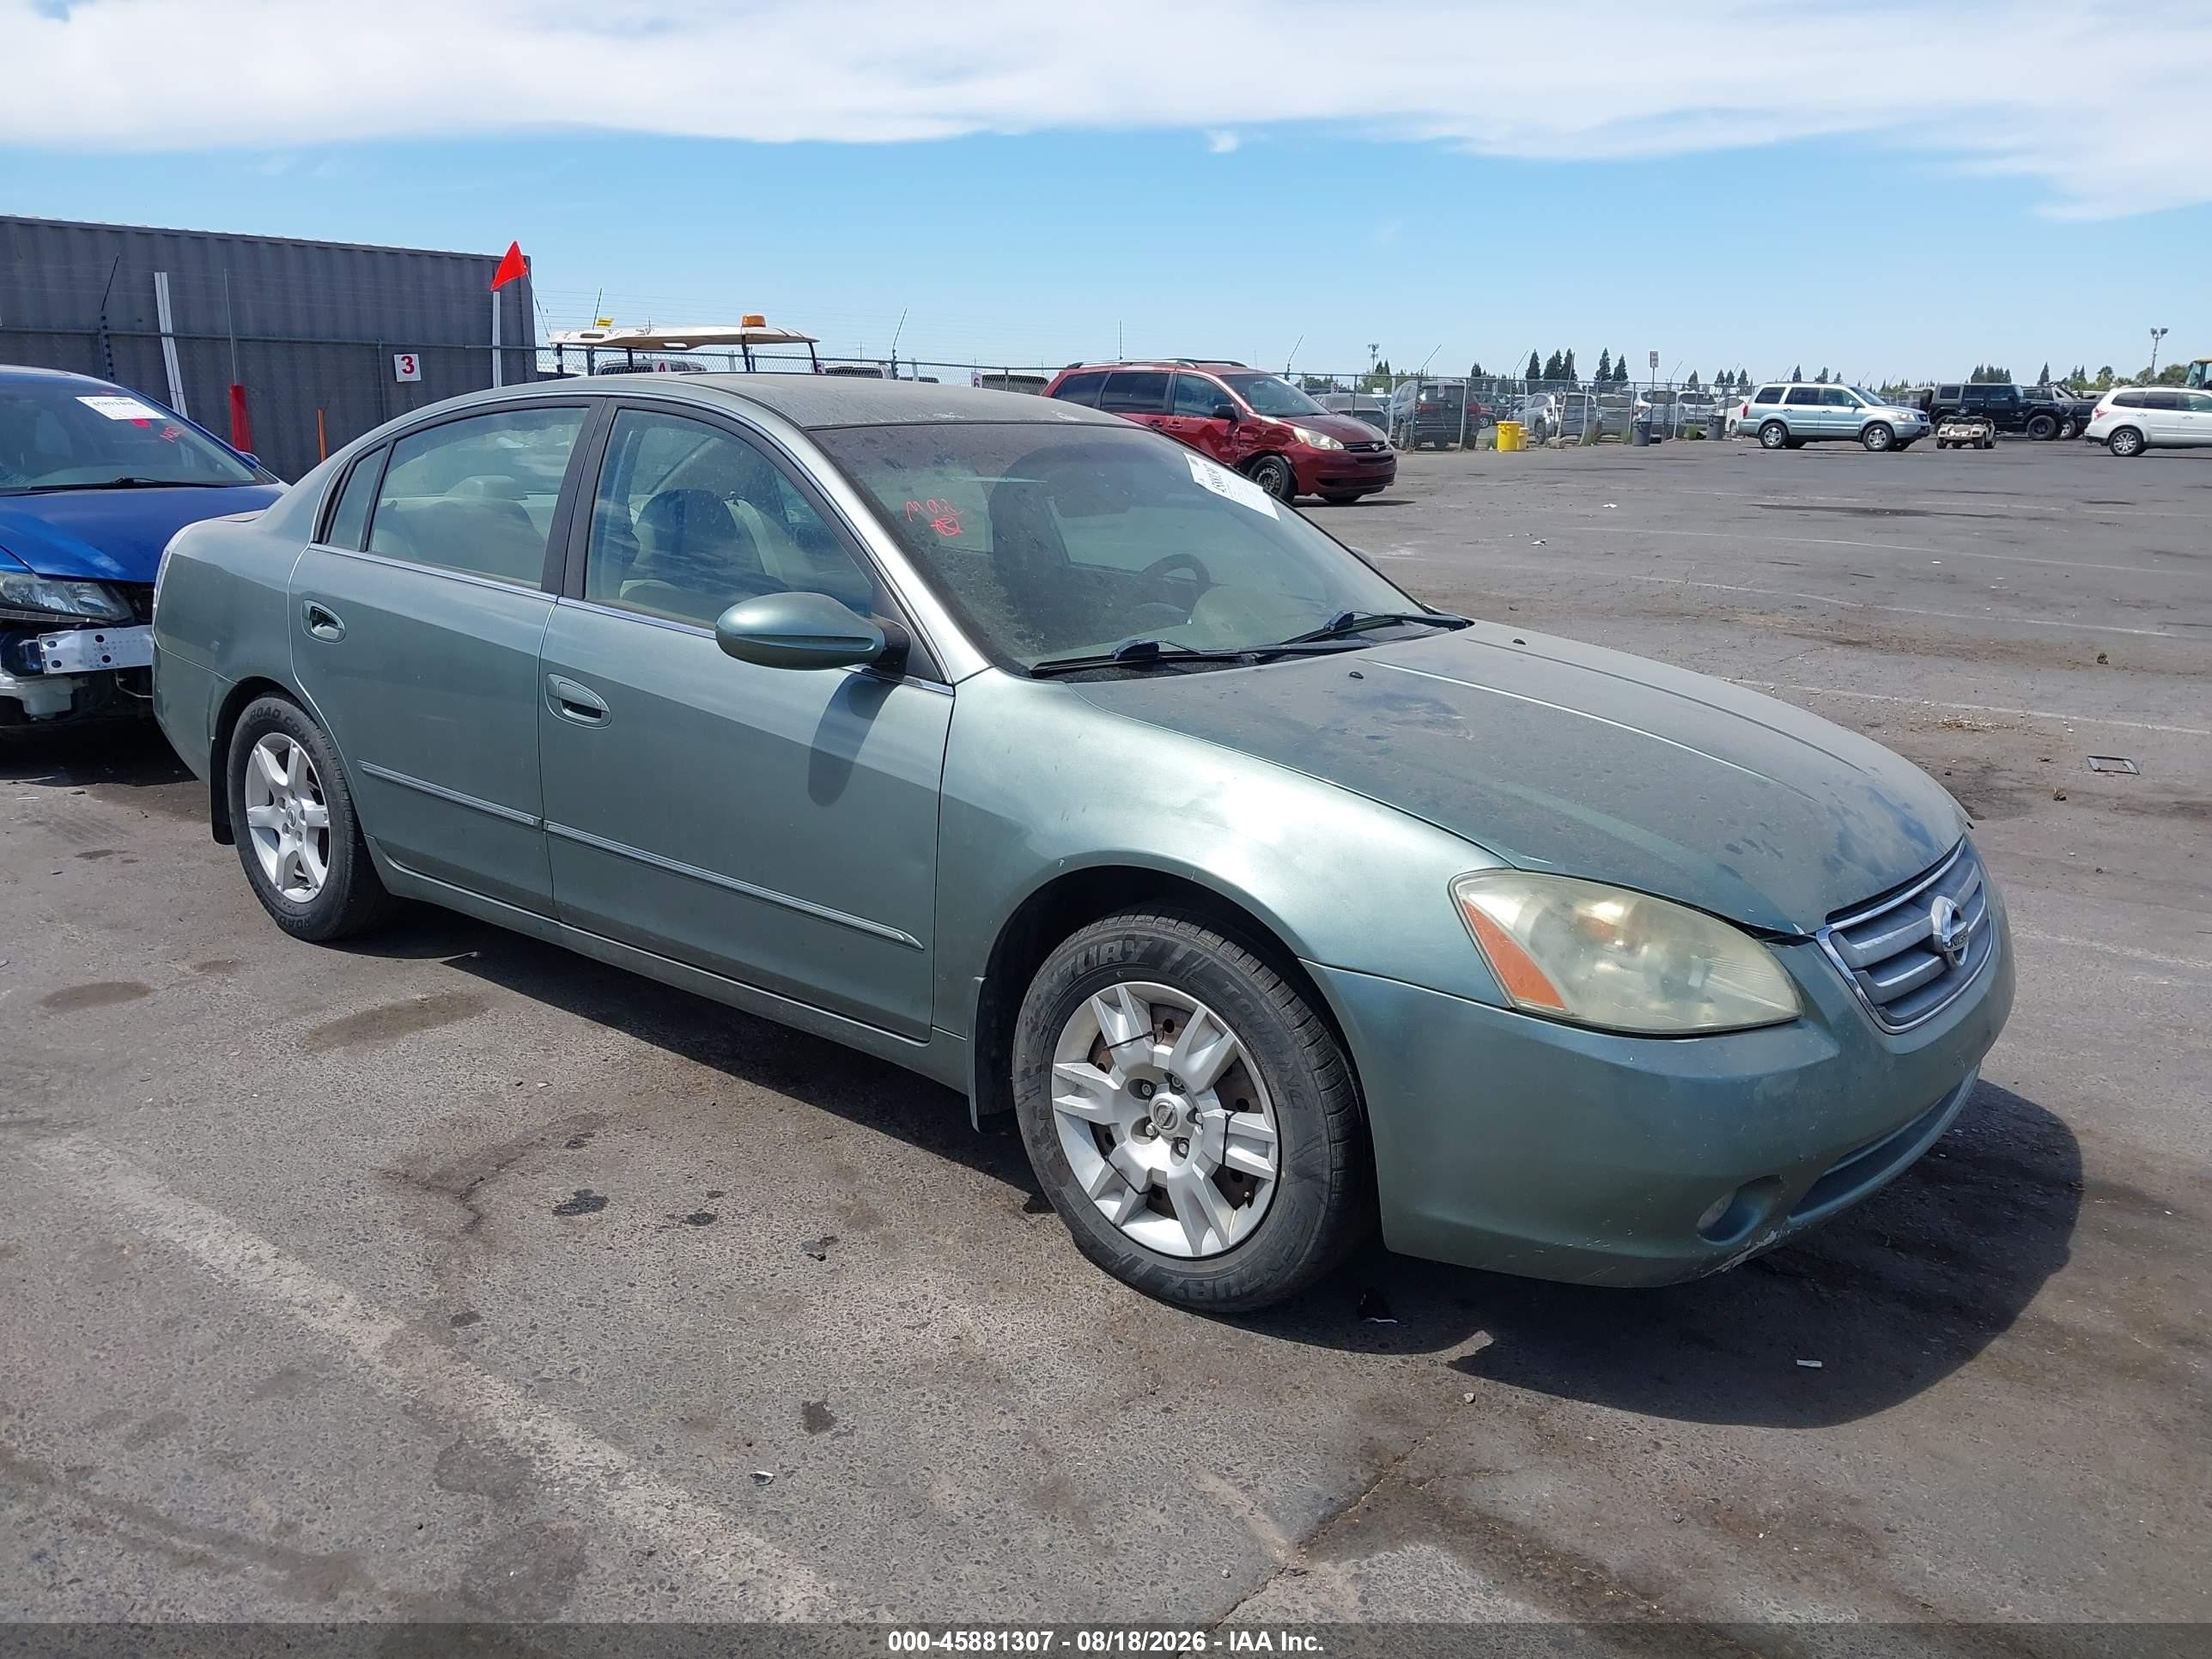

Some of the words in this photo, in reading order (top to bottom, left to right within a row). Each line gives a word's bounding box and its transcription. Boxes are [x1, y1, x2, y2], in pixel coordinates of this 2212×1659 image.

[401, 356, 416, 374] 3
[1333, 382, 1339, 393] 9
[250, 706, 282, 722] ROAD
